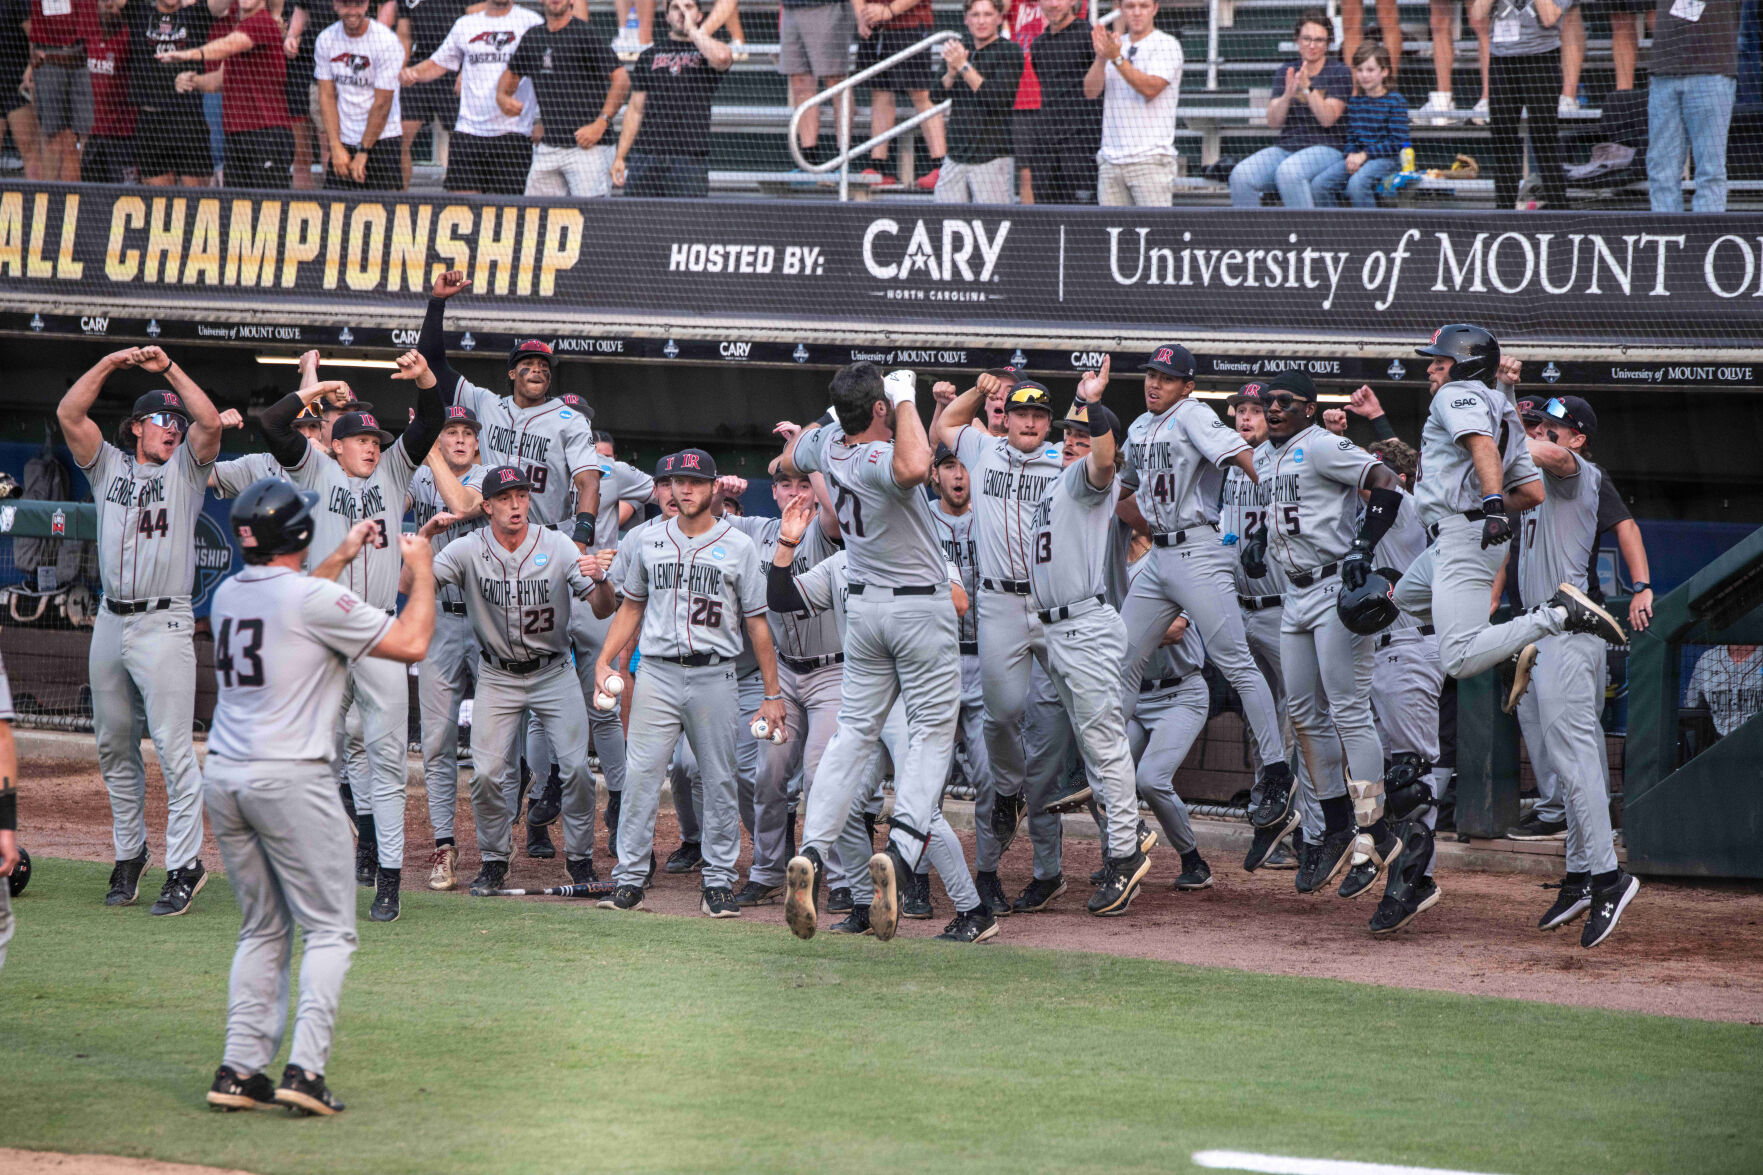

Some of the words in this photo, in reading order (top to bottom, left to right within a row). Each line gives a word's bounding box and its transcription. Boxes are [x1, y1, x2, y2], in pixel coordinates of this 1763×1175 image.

[104, 195, 585, 297] CHAMPIONSHIP
[669, 243, 773, 274] HOSTED
[782, 246, 825, 275] BY:
[862, 218, 1011, 282] CARY
[1106, 226, 1349, 310] University
[1362, 228, 1421, 311] of
[1431, 231, 1686, 297] MOUNT
[1704, 234, 1763, 299] O
[886, 289, 924, 300] NORTH
[929, 290, 986, 301] CAROLINA
[80, 316, 110, 332] CARY
[198, 325, 229, 340] University
[229, 326, 237, 340] of
[239, 326, 274, 339] MOUNT
[275, 327, 301, 340] OLIVE
[391, 329, 422, 345] CARY
[558, 338, 595, 352] MOUNT
[596, 340, 624, 353] OLIVE
[719, 341, 752, 357] CARY
[850, 350, 886, 364] University
[886, 351, 895, 364] of
[897, 350, 937, 362] MOUNT
[938, 351, 967, 363] OLIVE
[1070, 352, 1105, 367] CARY
[1213, 360, 1251, 374] University
[1252, 360, 1261, 374] of
[1263, 360, 1307, 372] MOUNT
[1308, 361, 1341, 374] OLIVE
[1611, 367, 1652, 382] University
[1653, 367, 1666, 382] of
[1668, 367, 1715, 380] MOUNT
[1717, 367, 1753, 381] OLIVE
[1452, 397, 1478, 408] SAC
[526, 464, 548, 494] 19
[983, 468, 1058, 502] LENOIR-RHYN
[1153, 473, 1175, 504] 41
[139, 508, 169, 540] 44
[1284, 506, 1301, 536] 5
[1036, 531, 1052, 564] 13
[480, 577, 550, 607] LENOIR-RHYNE
[654, 562, 722, 596] LENOIR-RHYNE
[524, 607, 555, 635] 23
[691, 597, 723, 628] 26
[216, 618, 265, 688] 43
